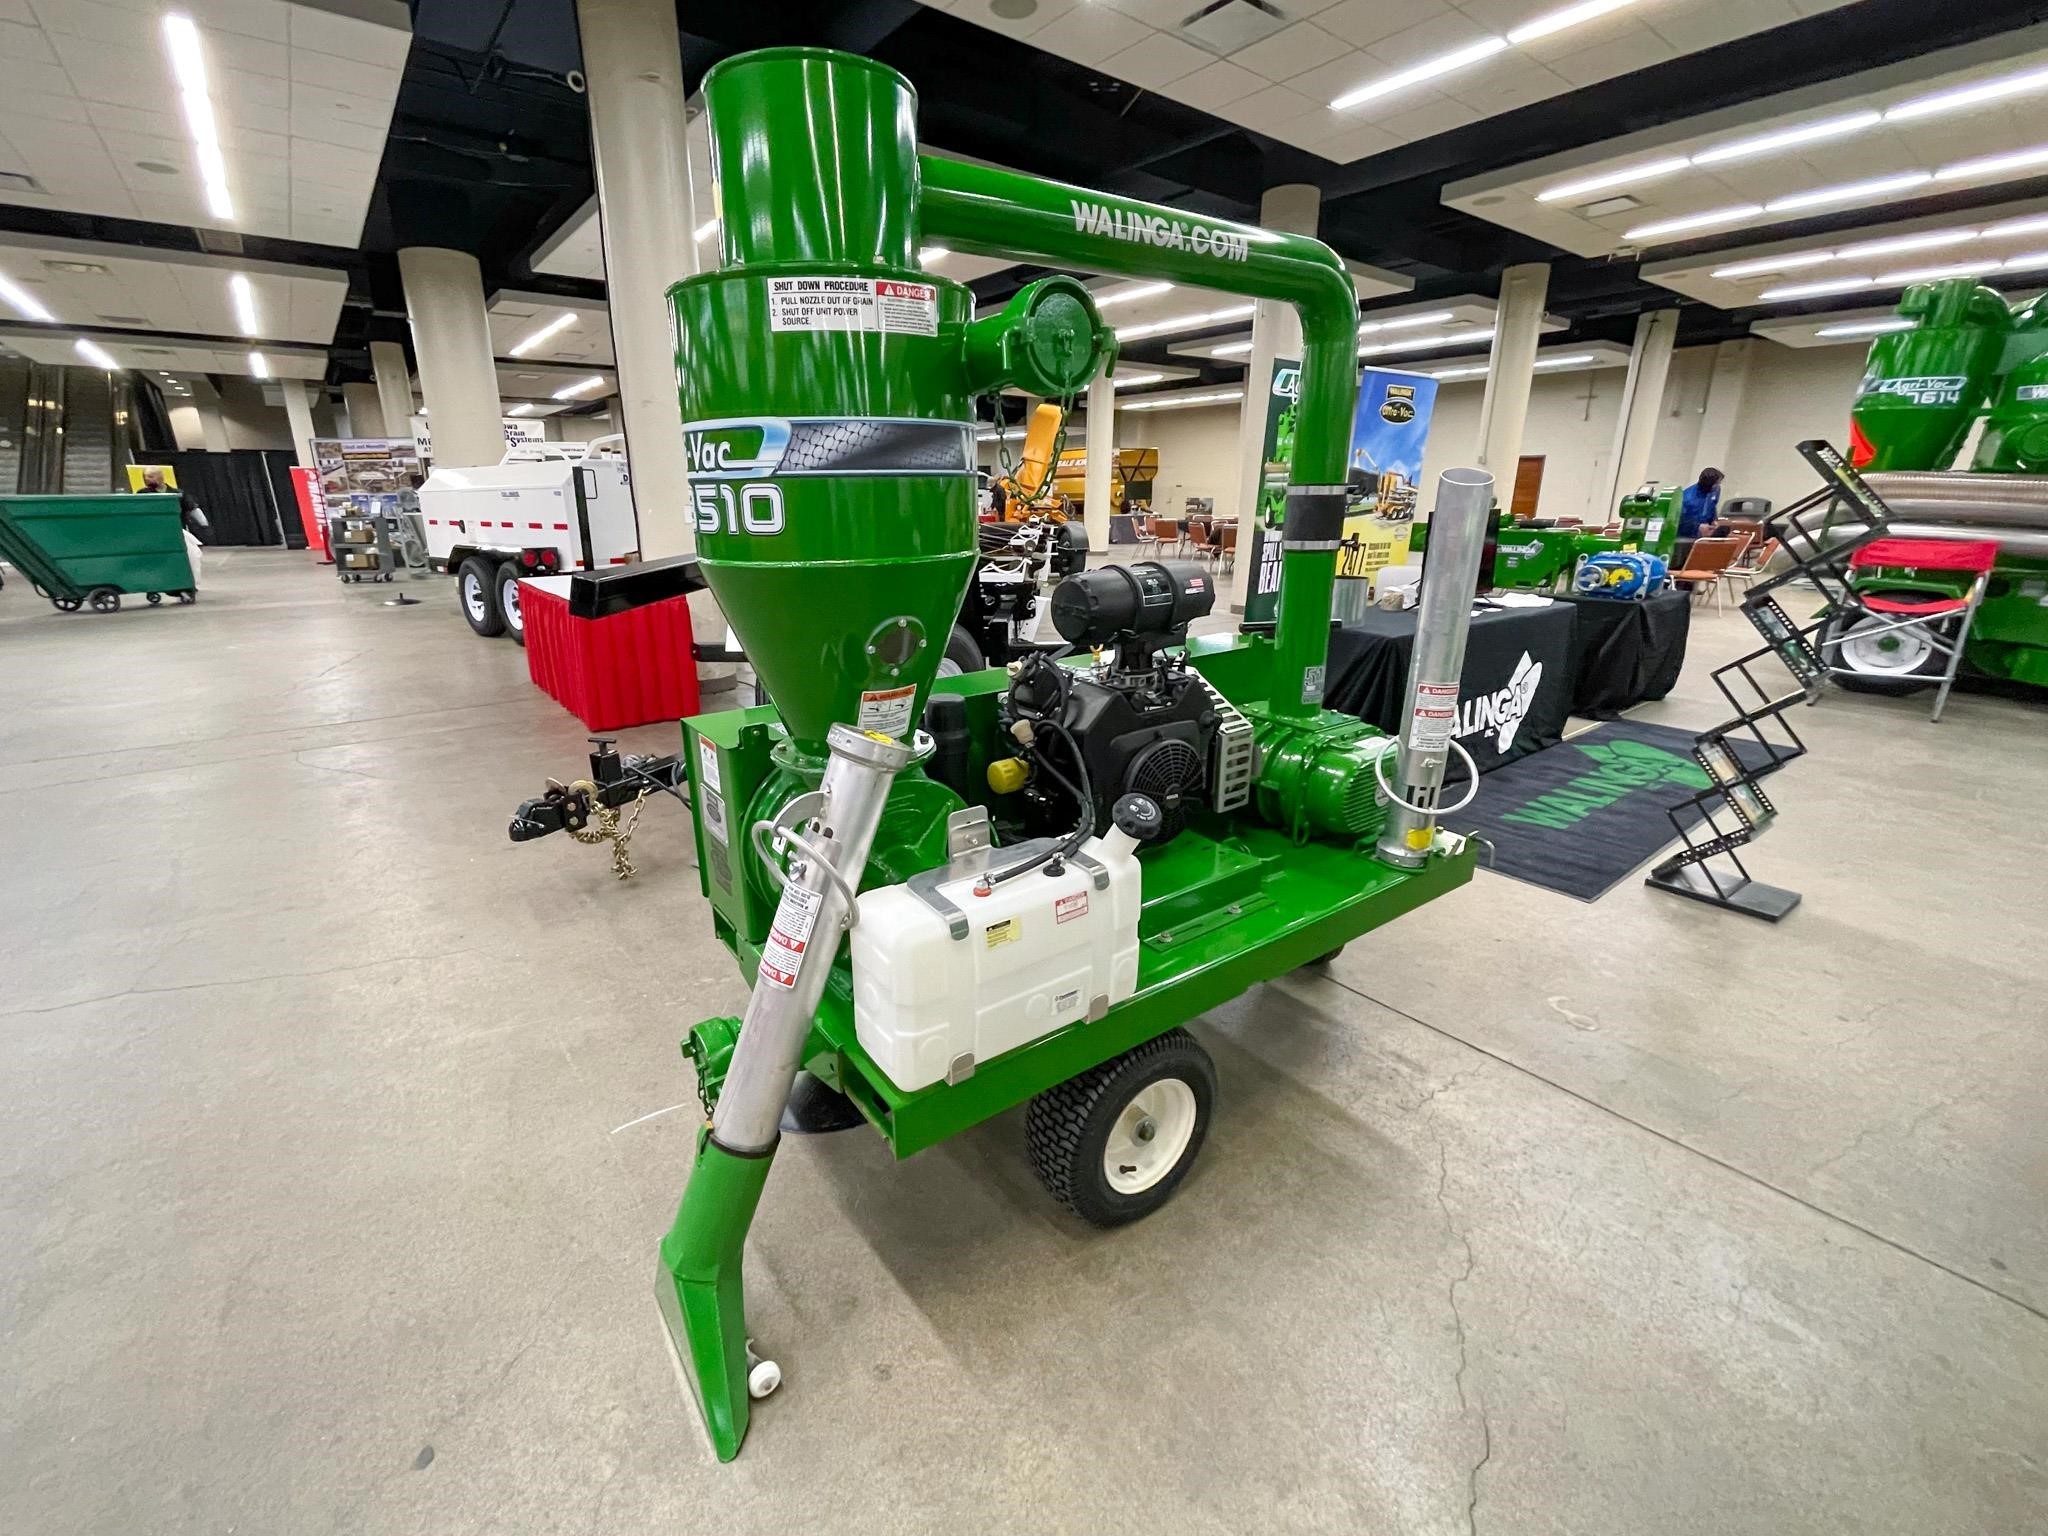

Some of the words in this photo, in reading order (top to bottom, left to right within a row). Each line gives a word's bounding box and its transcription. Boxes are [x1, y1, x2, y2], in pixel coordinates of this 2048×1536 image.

[774, 281, 793, 291] SHUT
[798, 281, 821, 291] DOWN
[824, 281, 868, 292] PROCEDURE
[781, 297, 798, 305] PULL
[800, 297, 825, 305] NOZZLE
[827, 297, 841, 305] OUT
[782, 308, 799, 316] SHUT
[802, 308, 813, 316] OFF
[816, 308, 831, 316] UNIT
[510, 437, 544, 448] Systems
[690, 483, 785, 535] 510
[1450, 683, 1523, 738] ALINGA
[1500, 757, 1685, 829] WALINGA
